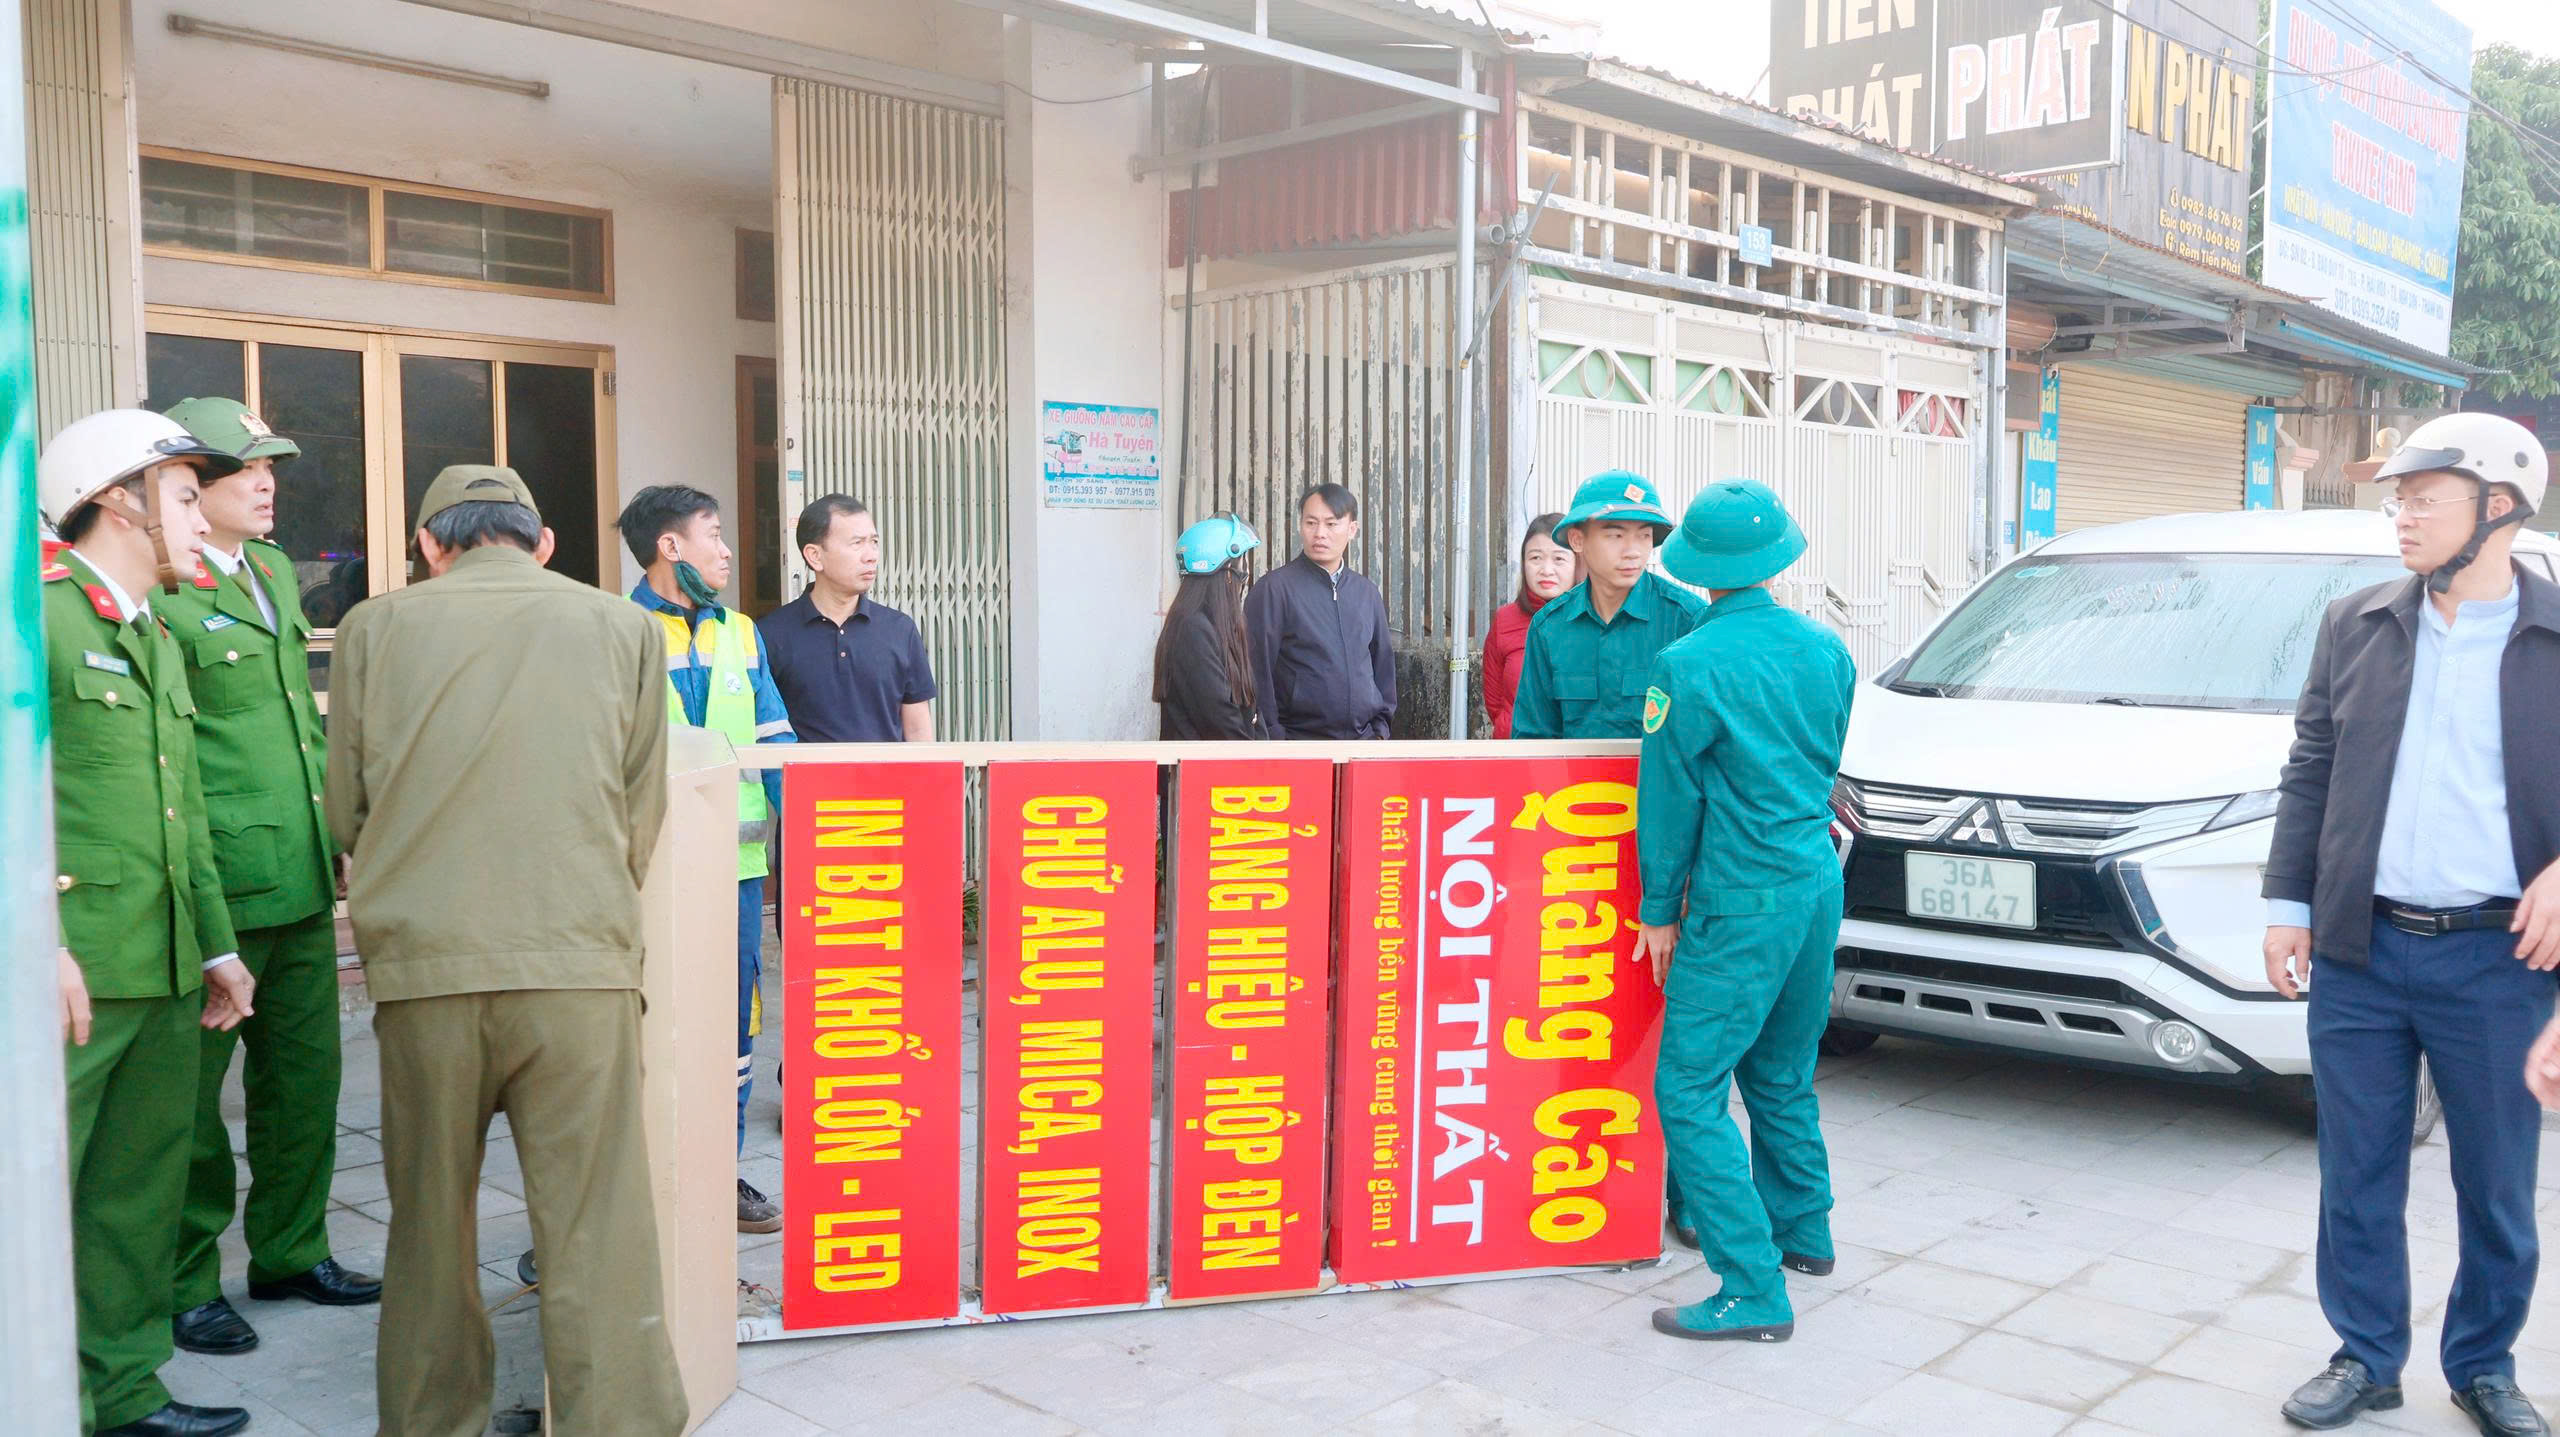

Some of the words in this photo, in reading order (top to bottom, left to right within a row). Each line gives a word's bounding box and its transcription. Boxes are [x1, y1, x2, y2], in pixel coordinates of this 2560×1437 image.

[1947, 5, 2099, 142] PHÁT
[2161, 39, 2250, 172] PHÁT
[1089, 432, 1108, 448] Hà
[2030, 482, 2051, 511] Lao
[815, 799, 903, 847] IN
[1021, 796, 1123, 893] CHỮ
[1208, 786, 1318, 912] BẢNG
[1381, 796, 1409, 852] Chất
[801, 864, 903, 950] BẠT
[1373, 859, 1408, 930] lượng
[1430, 797, 1508, 957] NỘI
[1921, 888, 2019, 922] 681.47
[1942, 861, 1995, 889] 36A
[1009, 905, 1105, 1005] ALU,
[1377, 937, 1406, 982] bền
[1504, 781, 1640, 1061] Quảng
[813, 966, 932, 1060] KHỔ
[1188, 926, 1304, 1029] HIỆU
[1370, 990, 1399, 1049] vững
[813, 1074, 921, 1163] LỚN
[1008, 1020, 1103, 1153] MICA,
[1185, 1075, 1300, 1165] HỘP
[1369, 1057, 1400, 1116] cùng
[1432, 979, 1510, 1245] THẤT
[1373, 1123, 1401, 1170] thời
[1529, 1088, 1641, 1243] Cáo
[1017, 1168, 1101, 1278] INOX
[1202, 1179, 1298, 1270] ĐÈN
[1368, 1178, 1398, 1231] gian
[814, 1209, 901, 1292] LED
